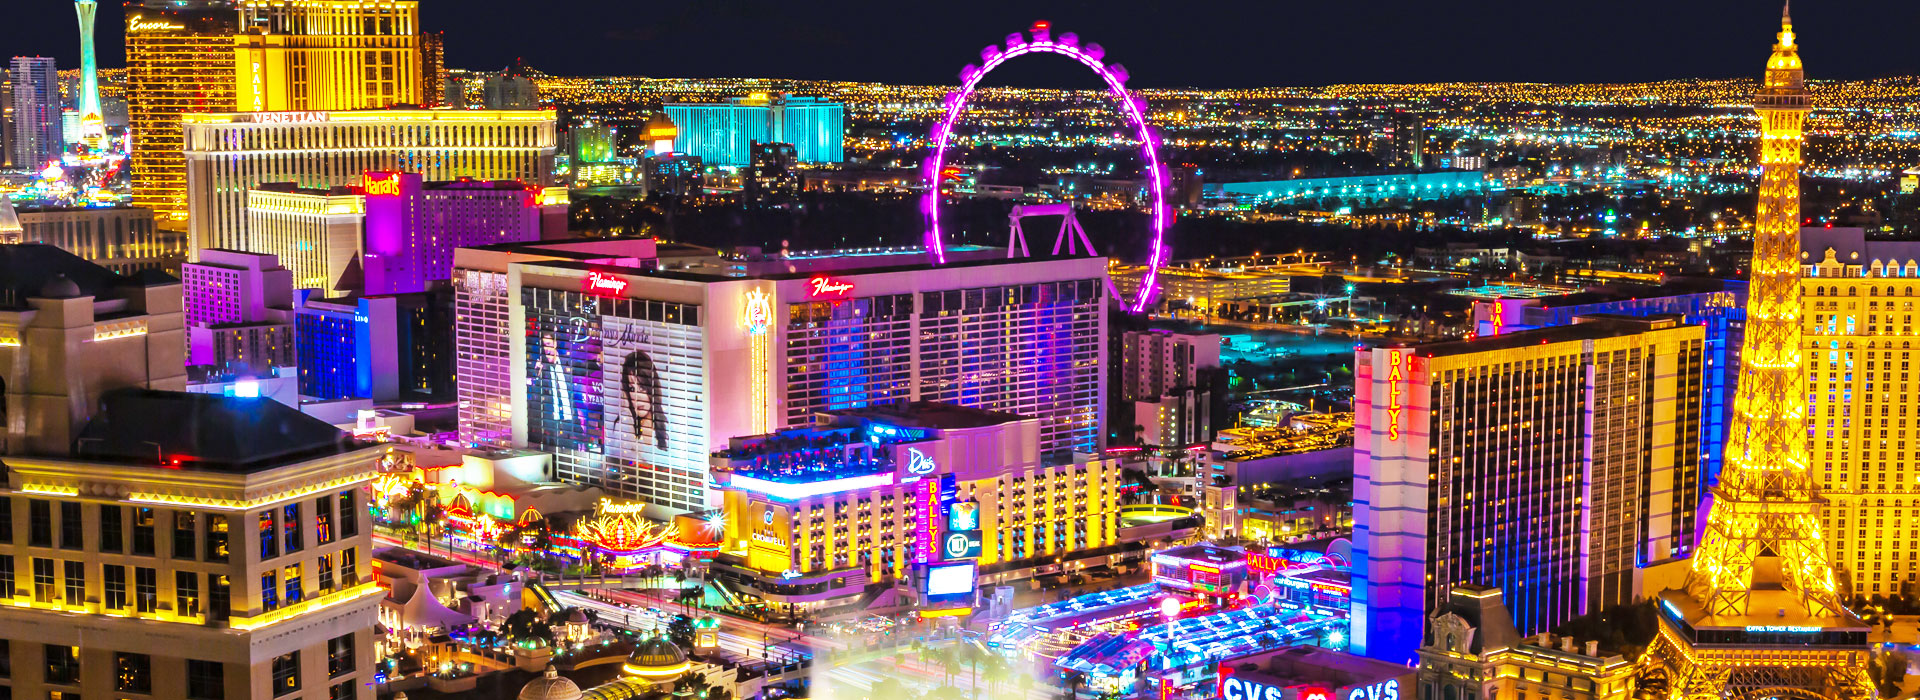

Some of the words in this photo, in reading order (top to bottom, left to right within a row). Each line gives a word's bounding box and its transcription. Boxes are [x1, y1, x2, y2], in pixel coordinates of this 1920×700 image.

[130, 15, 184, 31] Encore
[252, 112, 328, 123] VENETIAN
[589, 271, 627, 295] Flamingo
[811, 277, 853, 297] Flamingo
[1388, 351, 1402, 441] BALLYS
[600, 497, 646, 519] Flamingo
[928, 481, 939, 554] BALLYS
[1247, 552, 1288, 571] BALLY'S
[1223, 677, 1282, 700] CVS
